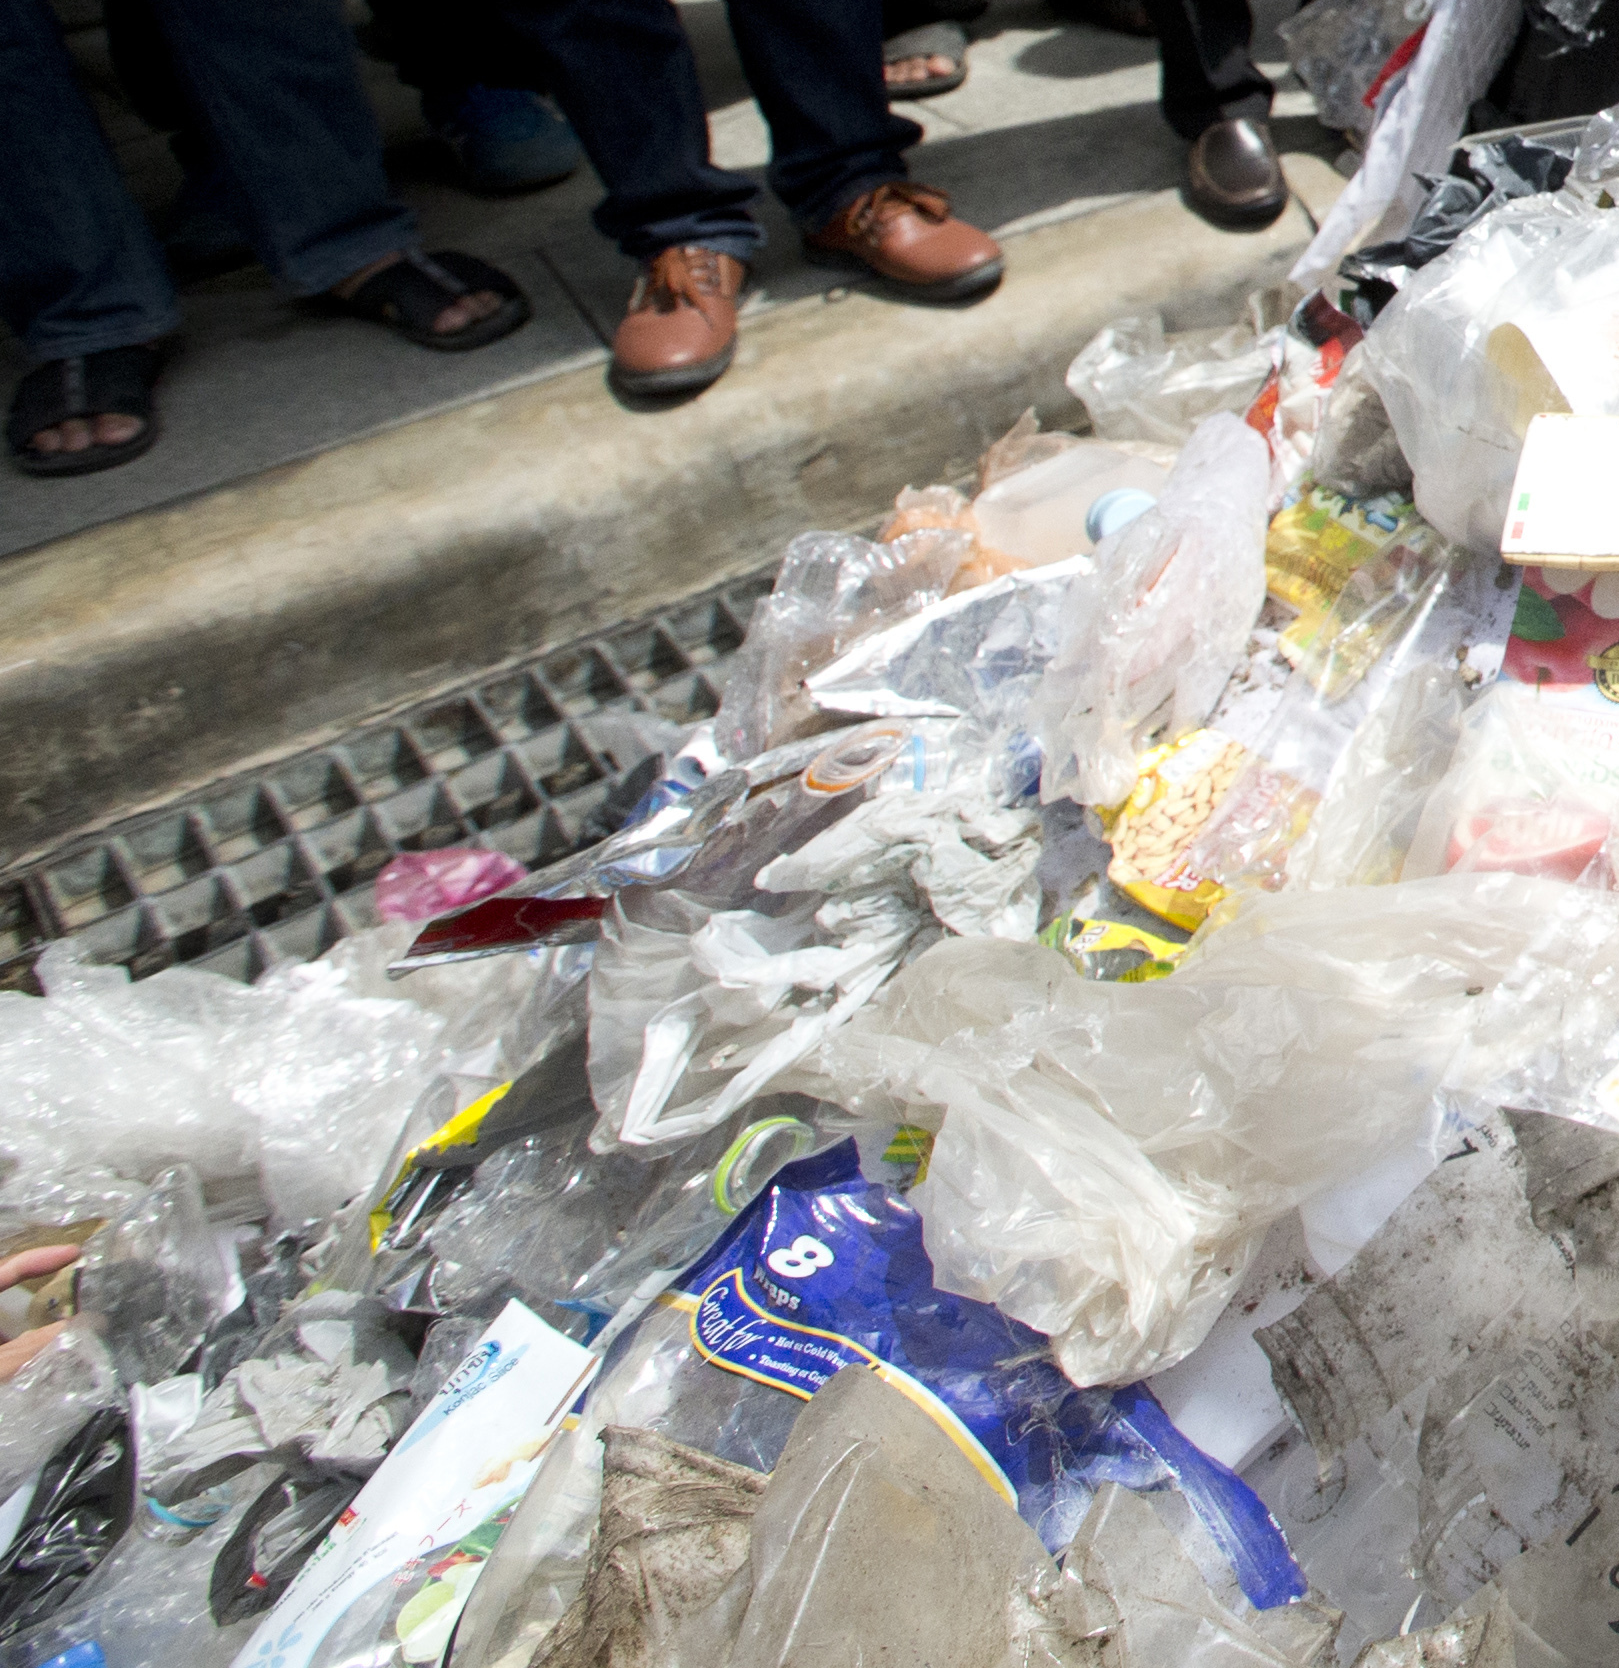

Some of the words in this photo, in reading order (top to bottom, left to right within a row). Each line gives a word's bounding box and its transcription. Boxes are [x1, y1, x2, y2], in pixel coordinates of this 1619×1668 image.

[767, 1234, 835, 1278] 8
[752, 1264, 802, 1311] Wraps
[701, 1285, 746, 1346] Great
[758, 1353, 801, 1378] Toasting
[774, 1334, 795, 1350] Hot
[803, 1342, 828, 1359] Cold
[442, 1380, 488, 1416] Konjac
[489, 1356, 521, 1383] Slice
